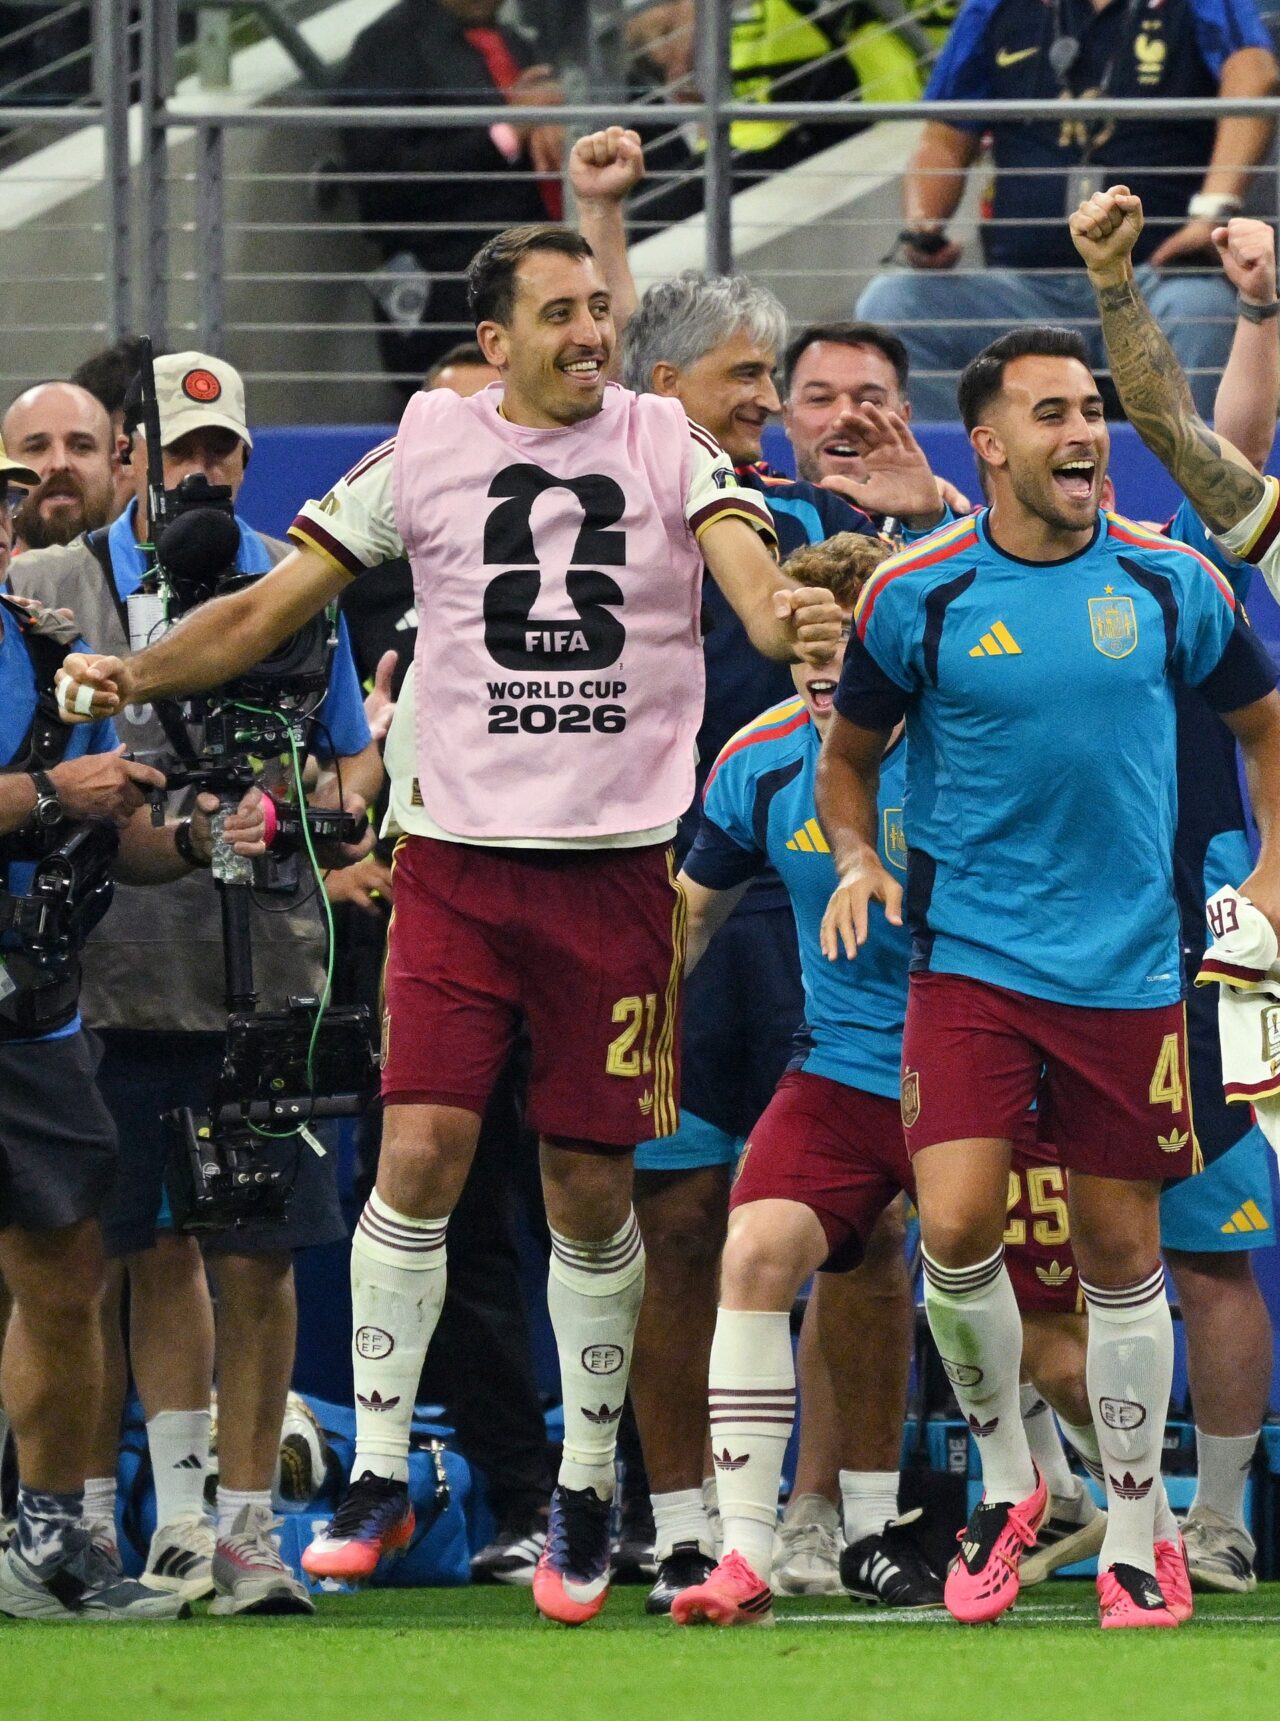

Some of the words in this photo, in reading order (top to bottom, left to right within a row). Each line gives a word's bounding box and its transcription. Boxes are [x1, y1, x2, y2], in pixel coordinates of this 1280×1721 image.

[525, 630, 590, 652] FIFA
[486, 681, 574, 699] WORLD
[579, 680, 627, 698] CUP
[488, 704, 626, 734] 2026
[606, 994, 657, 1077] 21
[1149, 1032, 1184, 1114] 4
